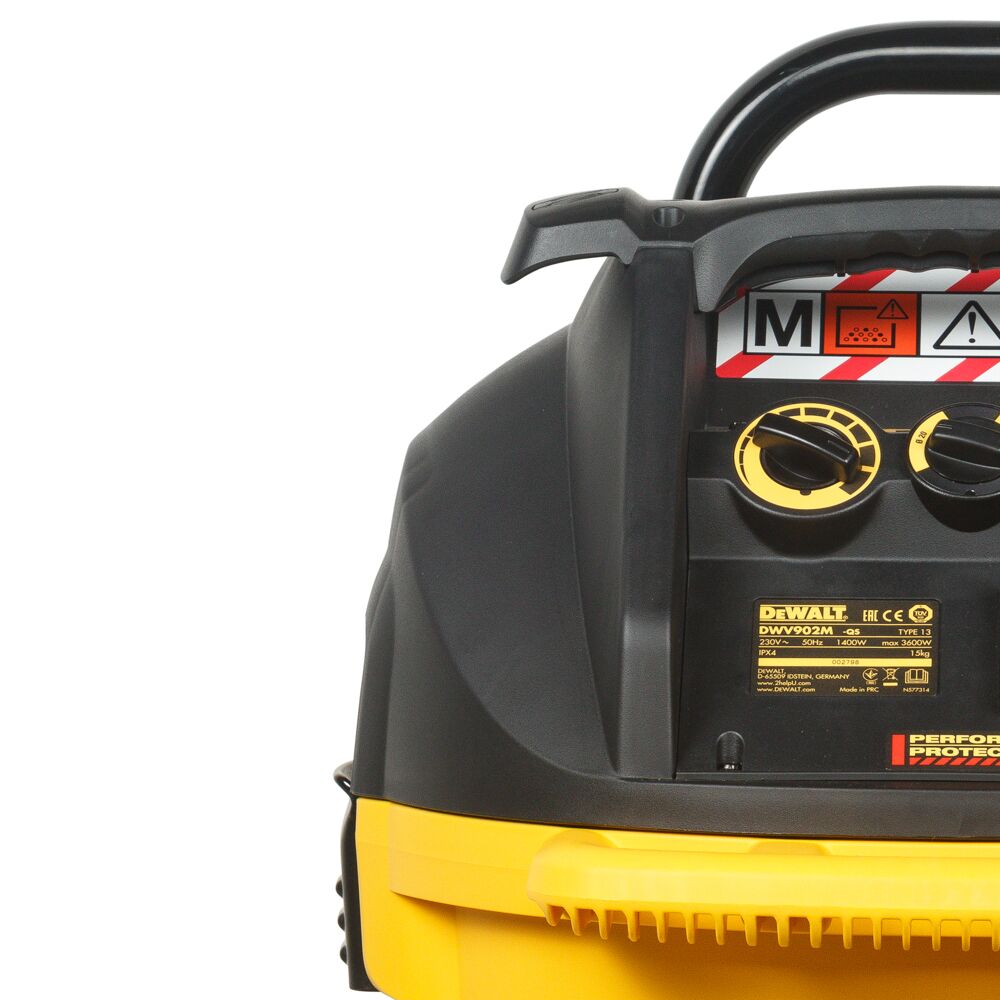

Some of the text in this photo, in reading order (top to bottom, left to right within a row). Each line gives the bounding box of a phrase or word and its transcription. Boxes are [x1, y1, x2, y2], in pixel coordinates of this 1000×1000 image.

[754, 298, 814, 347] M
[882, 609, 904, 622] CE
[758, 625, 834, 635] DWV902M
[898, 628, 918, 636] TYPE
[801, 638, 824, 646] 50Hz
[910, 650, 930, 658] 15kg
